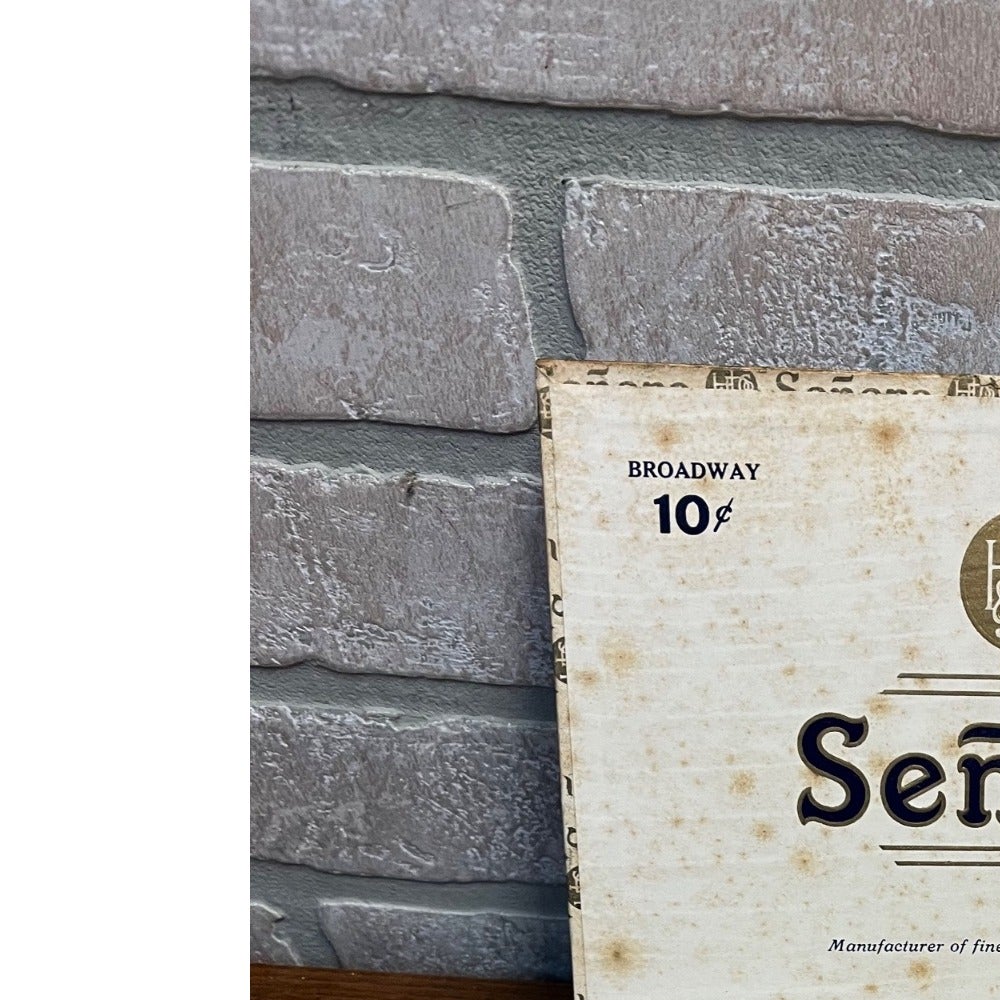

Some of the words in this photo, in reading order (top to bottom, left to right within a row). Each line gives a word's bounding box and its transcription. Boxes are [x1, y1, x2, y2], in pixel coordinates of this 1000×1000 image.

[628, 461, 760, 481] BROADWAY
[653, 494, 734, 535] 10¢
[828, 939, 944, 954] Manufacturer
[950, 939, 970, 954] of
